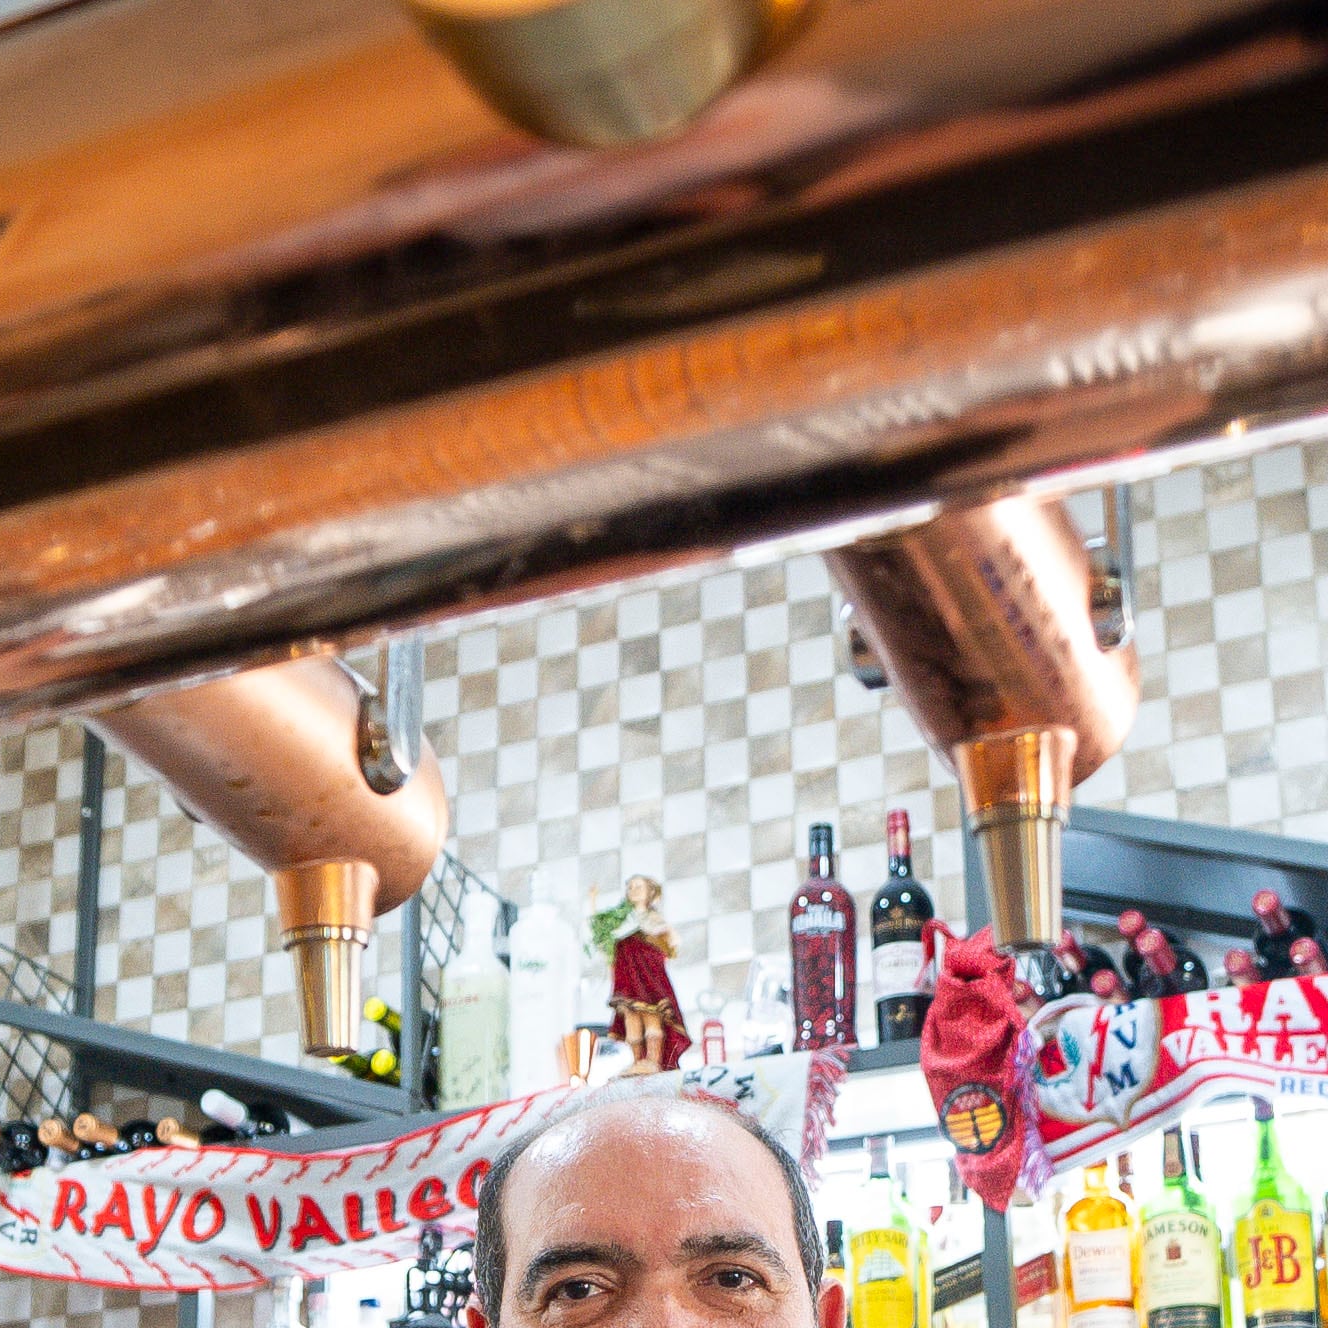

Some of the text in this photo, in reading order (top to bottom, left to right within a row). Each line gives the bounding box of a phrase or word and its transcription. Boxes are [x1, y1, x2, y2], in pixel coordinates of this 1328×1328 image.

[49, 1157, 492, 1257] RAYO VALLEC
[1245, 1233, 1301, 1290] J&B
